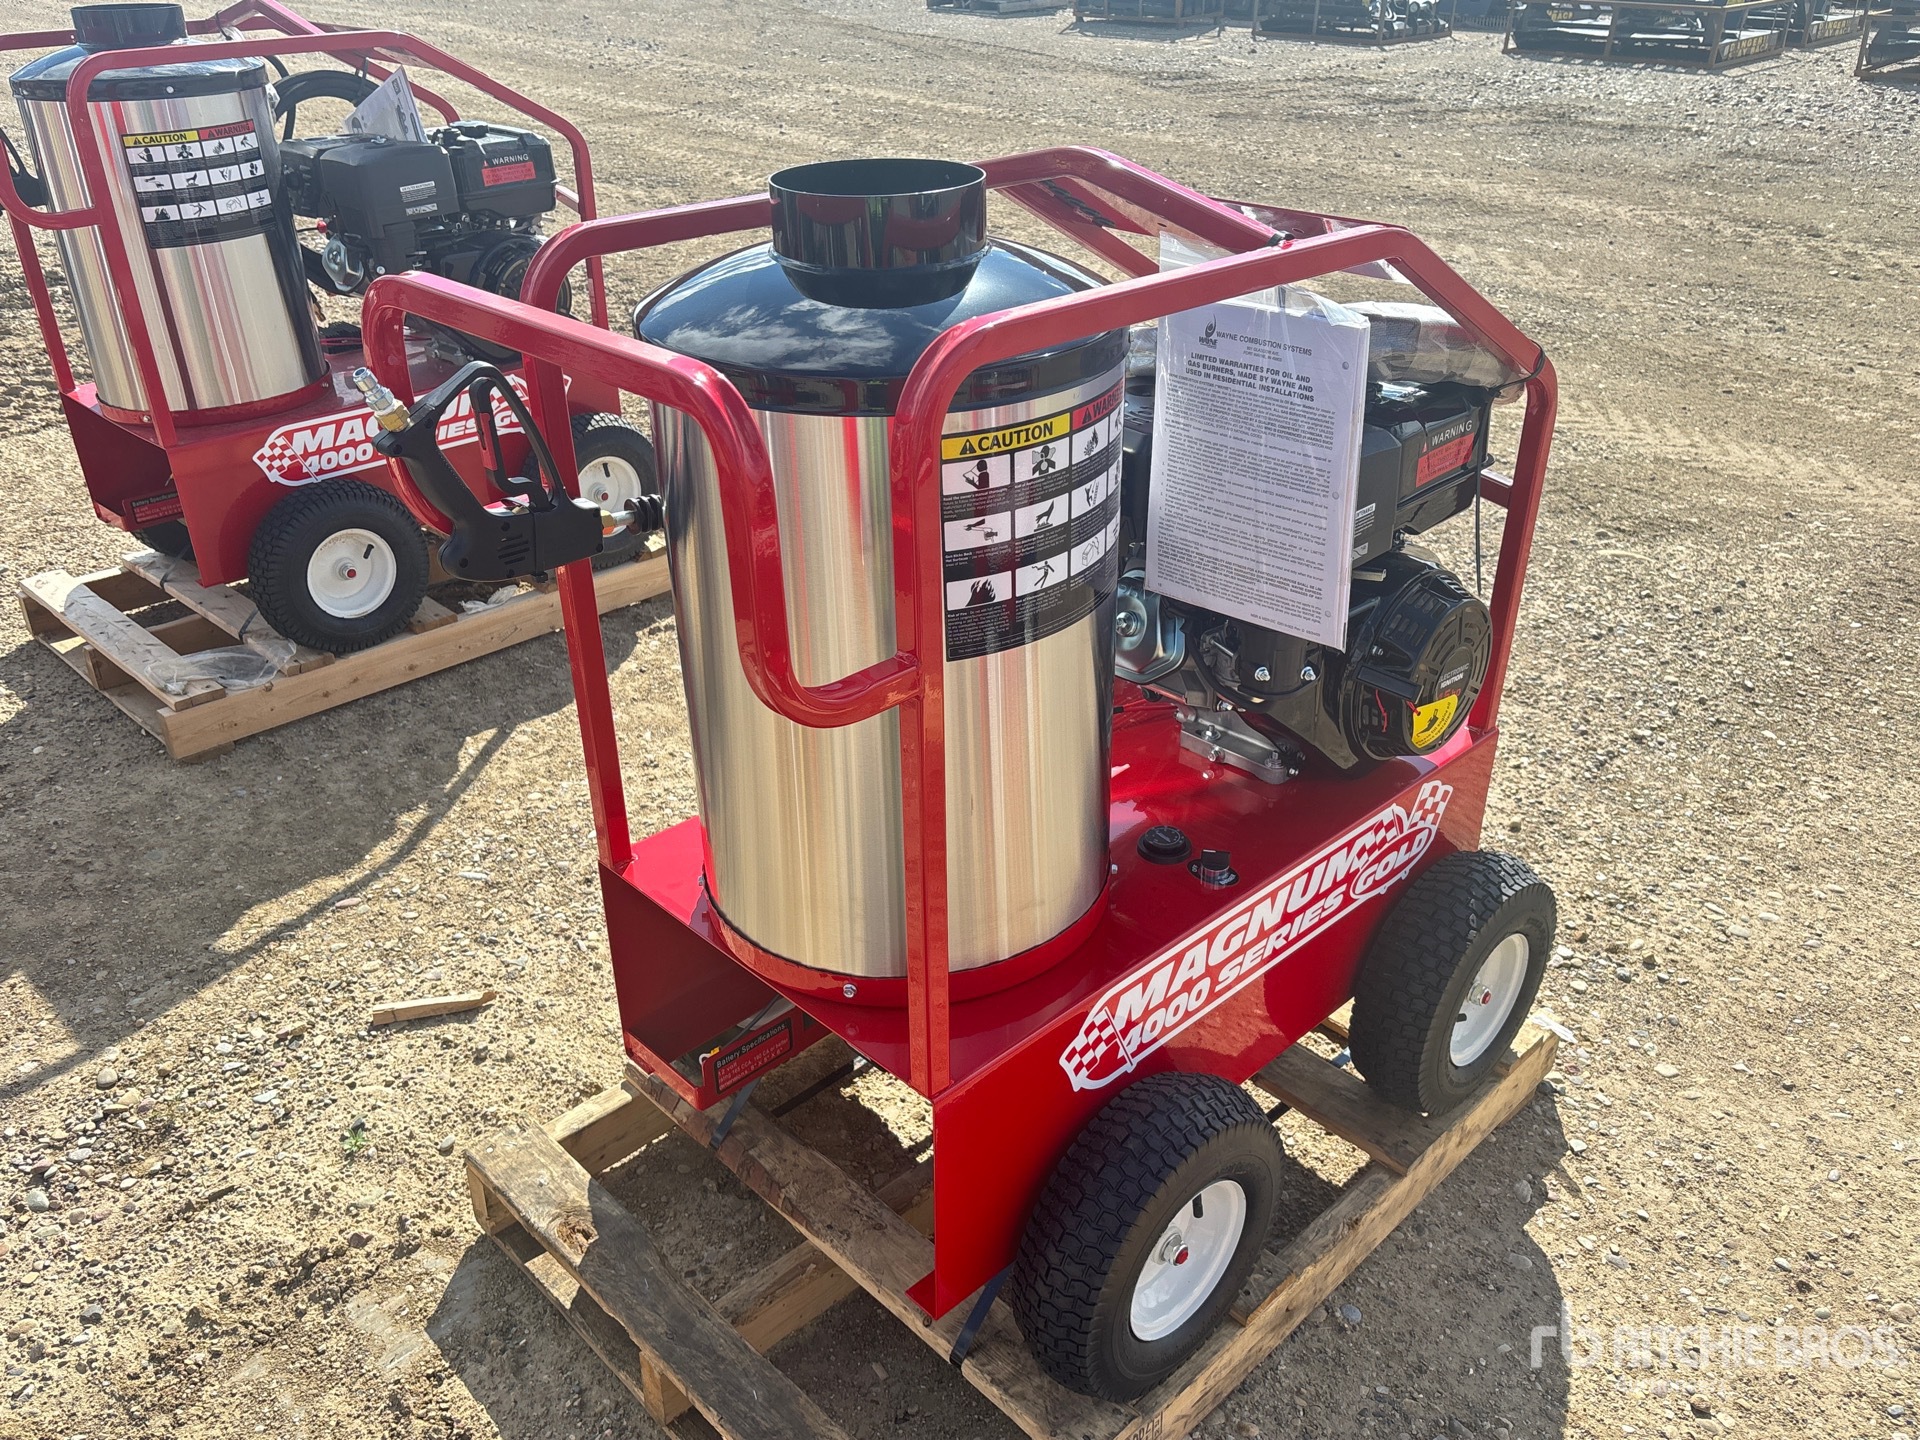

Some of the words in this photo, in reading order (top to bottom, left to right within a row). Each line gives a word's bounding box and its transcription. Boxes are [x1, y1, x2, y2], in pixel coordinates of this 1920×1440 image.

[143, 133, 188, 144] CAUTION
[215, 124, 250, 137] WARNING
[492, 154, 529, 166] WARNING
[1216, 331, 1238, 341] WAYNE
[1240, 335, 1281, 349] COMBUSTION
[1283, 343, 1313, 356] SYSTEMS
[1187, 359, 1200, 368] GAS
[1202, 362, 1235, 376] BURNERS,
[1237, 370, 1256, 380] MADE
[1260, 374, 1268, 383] BY
[1270, 377, 1295, 389] WAYNE
[1298, 383, 1312, 392] AND
[1191, 351, 1217, 363] LIMITED
[1218, 357, 1263, 373] WARRANTIES
[1266, 367, 1279, 376] FOR
[1281, 371, 1293, 379] OIL
[1295, 374, 1310, 383] AND
[1185, 367, 1201, 377] USED
[1212, 373, 1256, 389] RESIDENTIAL
[1258, 383, 1314, 402] INSTALLATIONS
[978, 422, 1053, 450] CAUTION
[1432, 420, 1472, 446] WARNING
[300, 443, 374, 474] 4000
[1440, 672, 1464, 688] IGNITION
[1112, 832, 1374, 1031] MAGNUM
[1118, 977, 1211, 1057] 4000
[1214, 884, 1347, 992] SERIES
[1358, 832, 1428, 890] GOLD
[716, 1051, 740, 1068] Battery
[742, 1024, 785, 1053] Specifications
